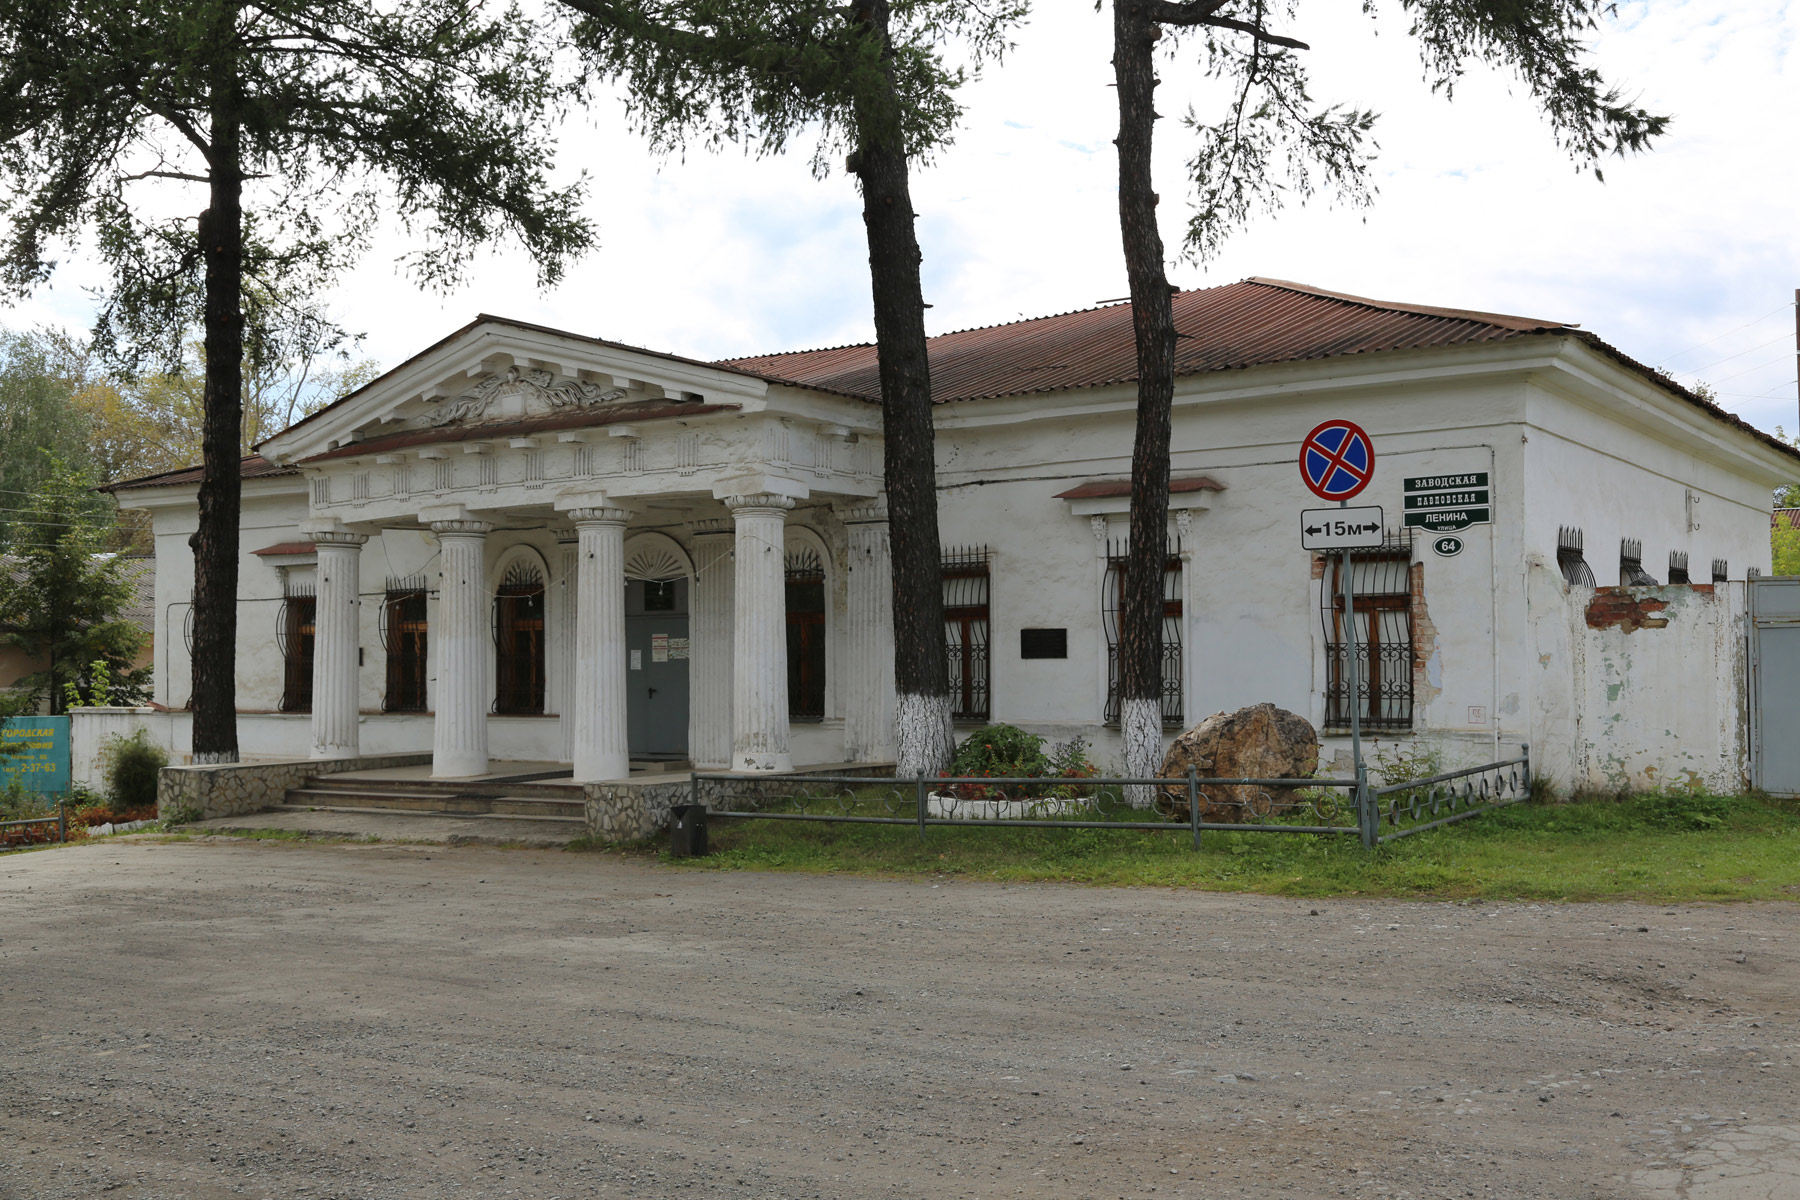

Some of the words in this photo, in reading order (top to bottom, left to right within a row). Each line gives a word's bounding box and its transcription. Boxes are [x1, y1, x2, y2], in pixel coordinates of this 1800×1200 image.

[1415, 475, 1477, 488] ЗАВОДСКАЯ
[1417, 493, 1476, 506] ПАВЛОВСКАЯ
[1425, 512, 1468, 523] ЛЕНИНА
[1322, 521, 1362, 537] 15м
[1441, 540, 1456, 551] 64
[1, 728, 55, 737] ГОРОДСКАЯ
[21, 763, 57, 773] 2-37-63
